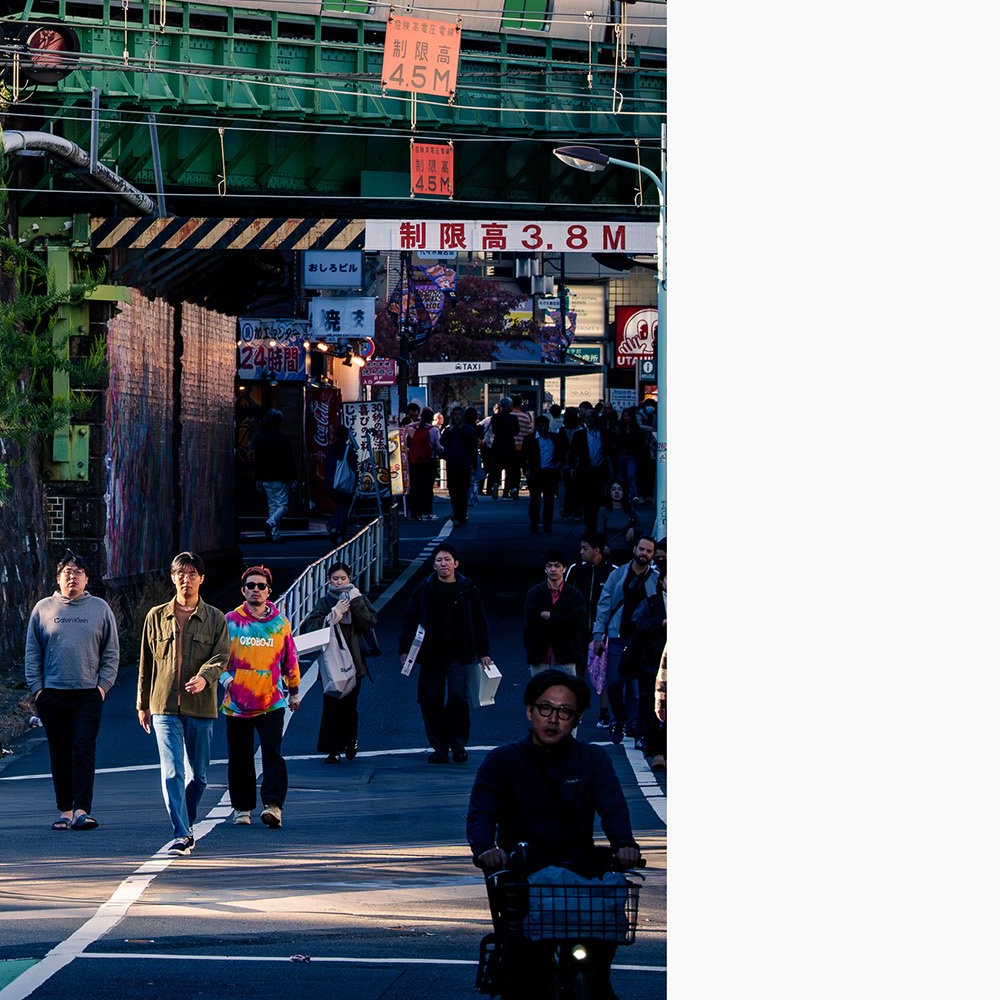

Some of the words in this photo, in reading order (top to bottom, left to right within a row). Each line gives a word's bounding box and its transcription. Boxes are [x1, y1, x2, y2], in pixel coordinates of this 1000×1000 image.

[392, 38, 452, 65] 制限高
[388, 63, 451, 93] 4.5M
[415, 158, 450, 175] 制限高
[308, 262, 359, 274] おしろビル
[241, 345, 300, 373] 24時間
[463, 363, 482, 372] TAXI
